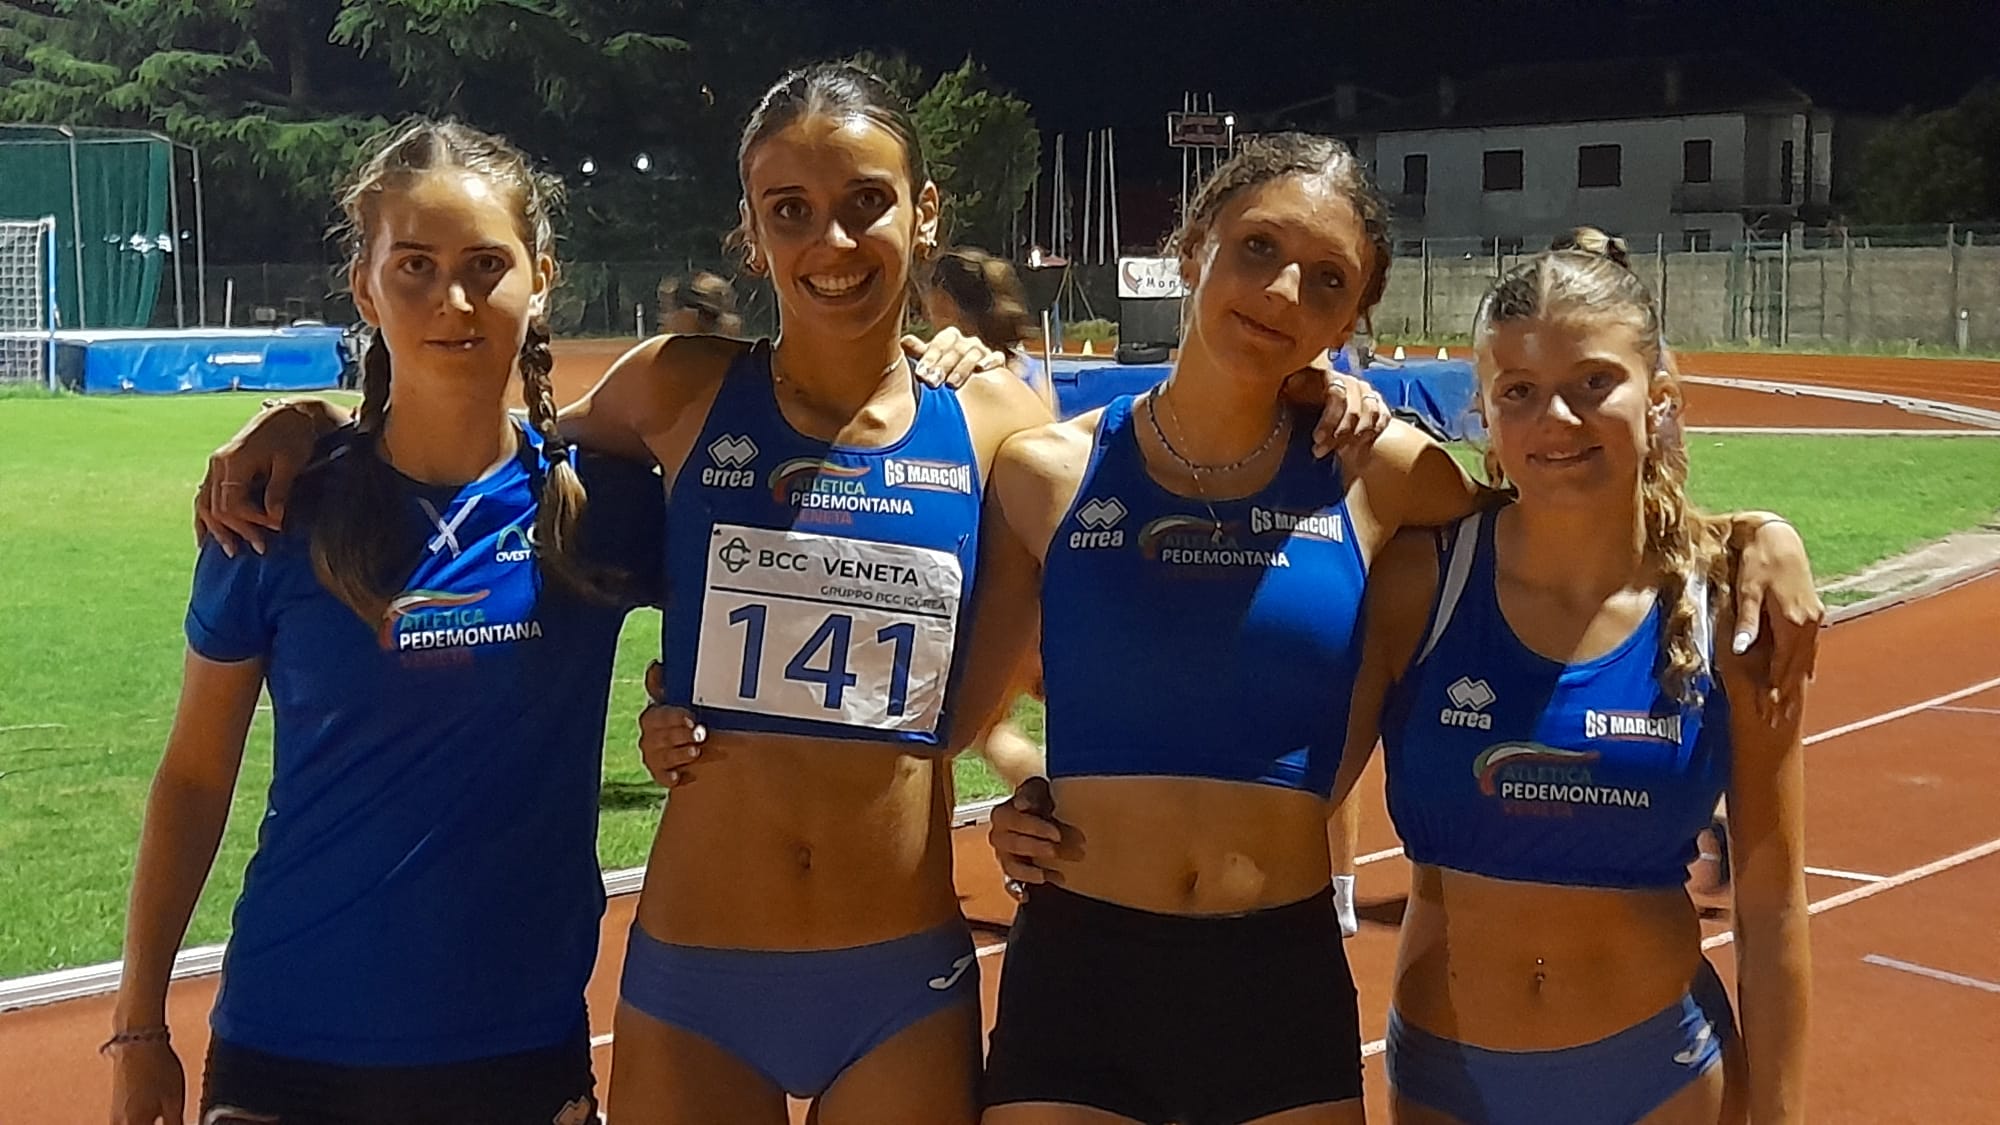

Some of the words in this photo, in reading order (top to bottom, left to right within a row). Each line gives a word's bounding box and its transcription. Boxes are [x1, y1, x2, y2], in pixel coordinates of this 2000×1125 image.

[701, 468, 755, 488] errea
[884, 459, 906, 487] GS
[907, 463, 972, 495] MARCONI
[790, 490, 915, 516] PEDEMONTANA
[794, 509, 854, 526] ENETA
[1251, 506, 1273, 534] GS
[1274, 512, 1345, 544] MARCONI
[1069, 529, 1125, 548] errea
[758, 549, 809, 572] BCC
[822, 556, 920, 587] VENETA
[1161, 548, 1291, 568] PEDEMONTANA
[820, 585, 873, 601] GRUPPO
[874, 591, 902, 605] BCC
[400, 608, 486, 631] ATLETICA
[399, 620, 543, 650] PEDEMONTANA
[728, 602, 917, 718] 141
[1440, 708, 1492, 730] errea
[1585, 709, 1608, 738] GS
[1609, 714, 1683, 745] MARCONI
[1500, 781, 1651, 808] PEDEMONTANA
